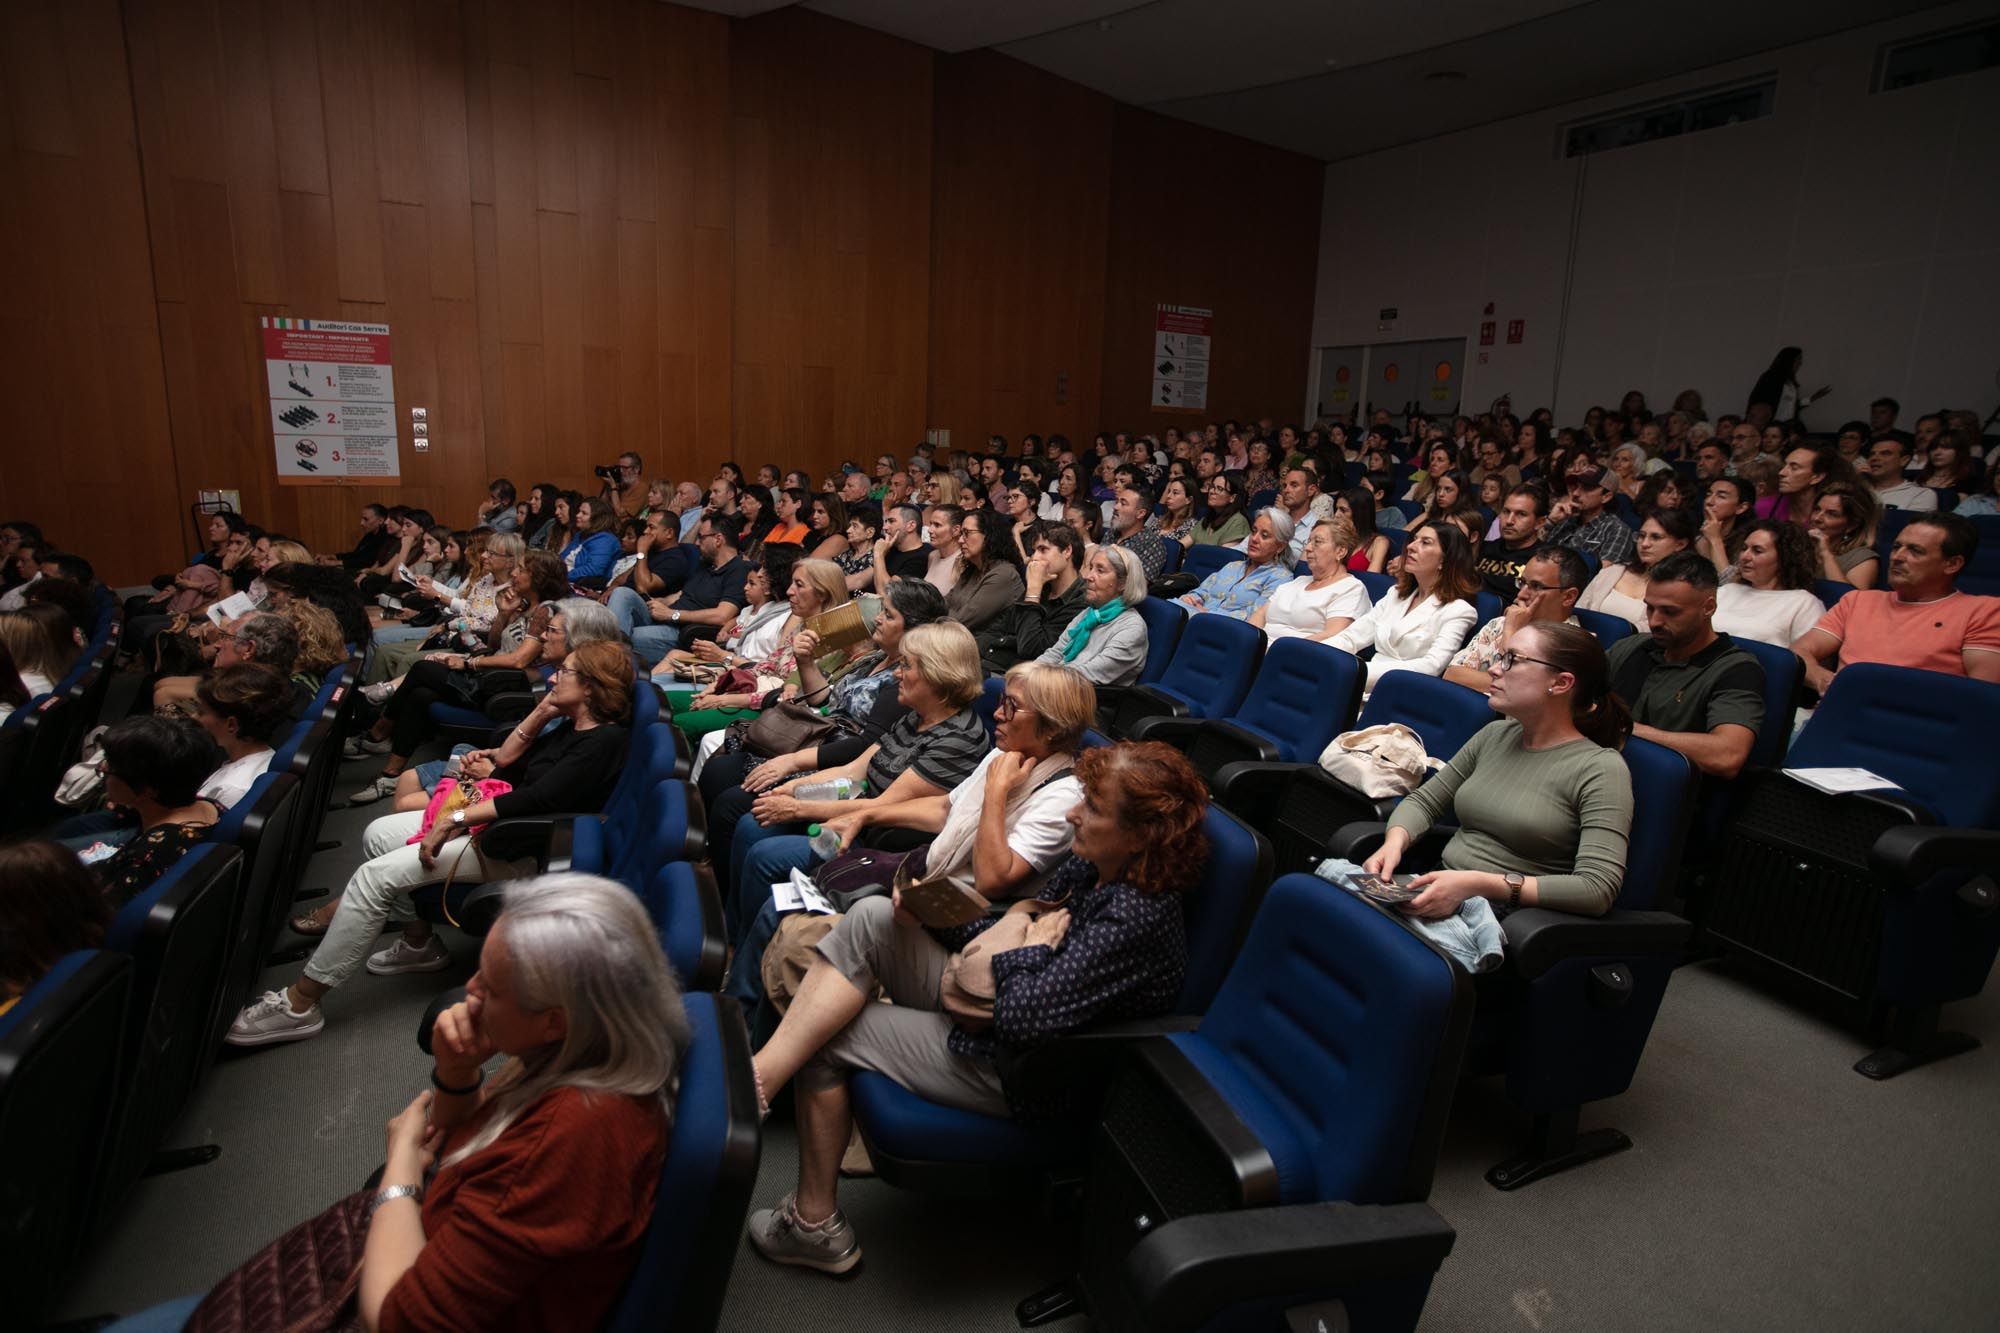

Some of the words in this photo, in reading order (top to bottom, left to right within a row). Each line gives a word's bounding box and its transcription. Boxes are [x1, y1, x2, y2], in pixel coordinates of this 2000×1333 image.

[317, 322, 347, 331] Auditori
[363, 325, 387, 333] Serres
[325, 376, 336, 387] 1.
[327, 413, 341, 424] 2.
[332, 450, 345, 462] 3.
